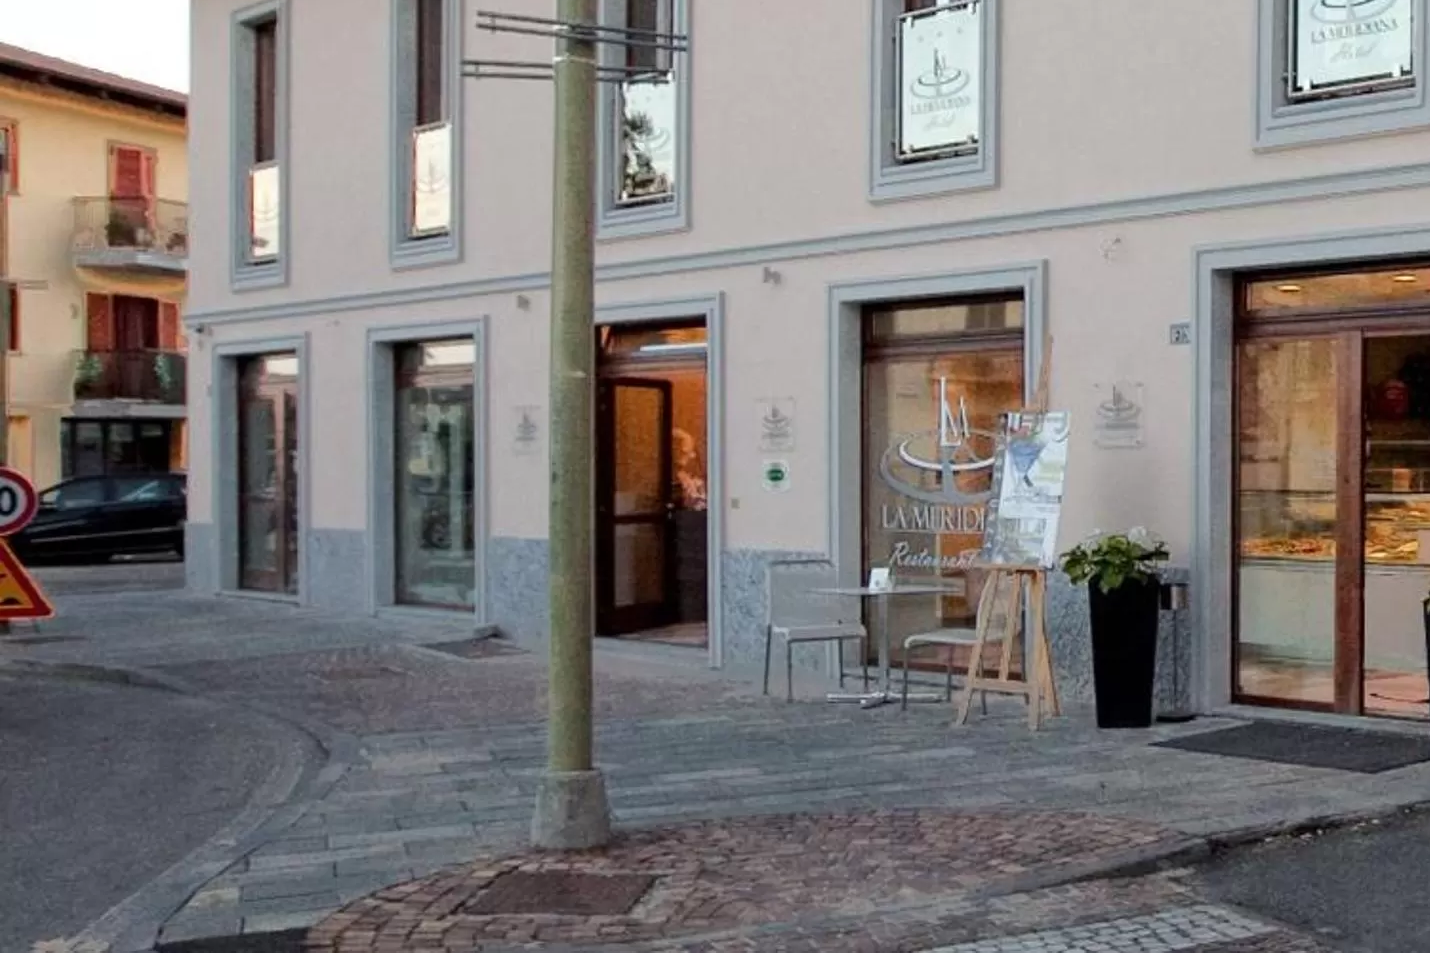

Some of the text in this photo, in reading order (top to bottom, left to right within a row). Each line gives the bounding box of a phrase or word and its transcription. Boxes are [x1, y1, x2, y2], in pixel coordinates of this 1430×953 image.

[0, 485, 16, 516] 0
[882, 504, 985, 532] LA MERIDI
